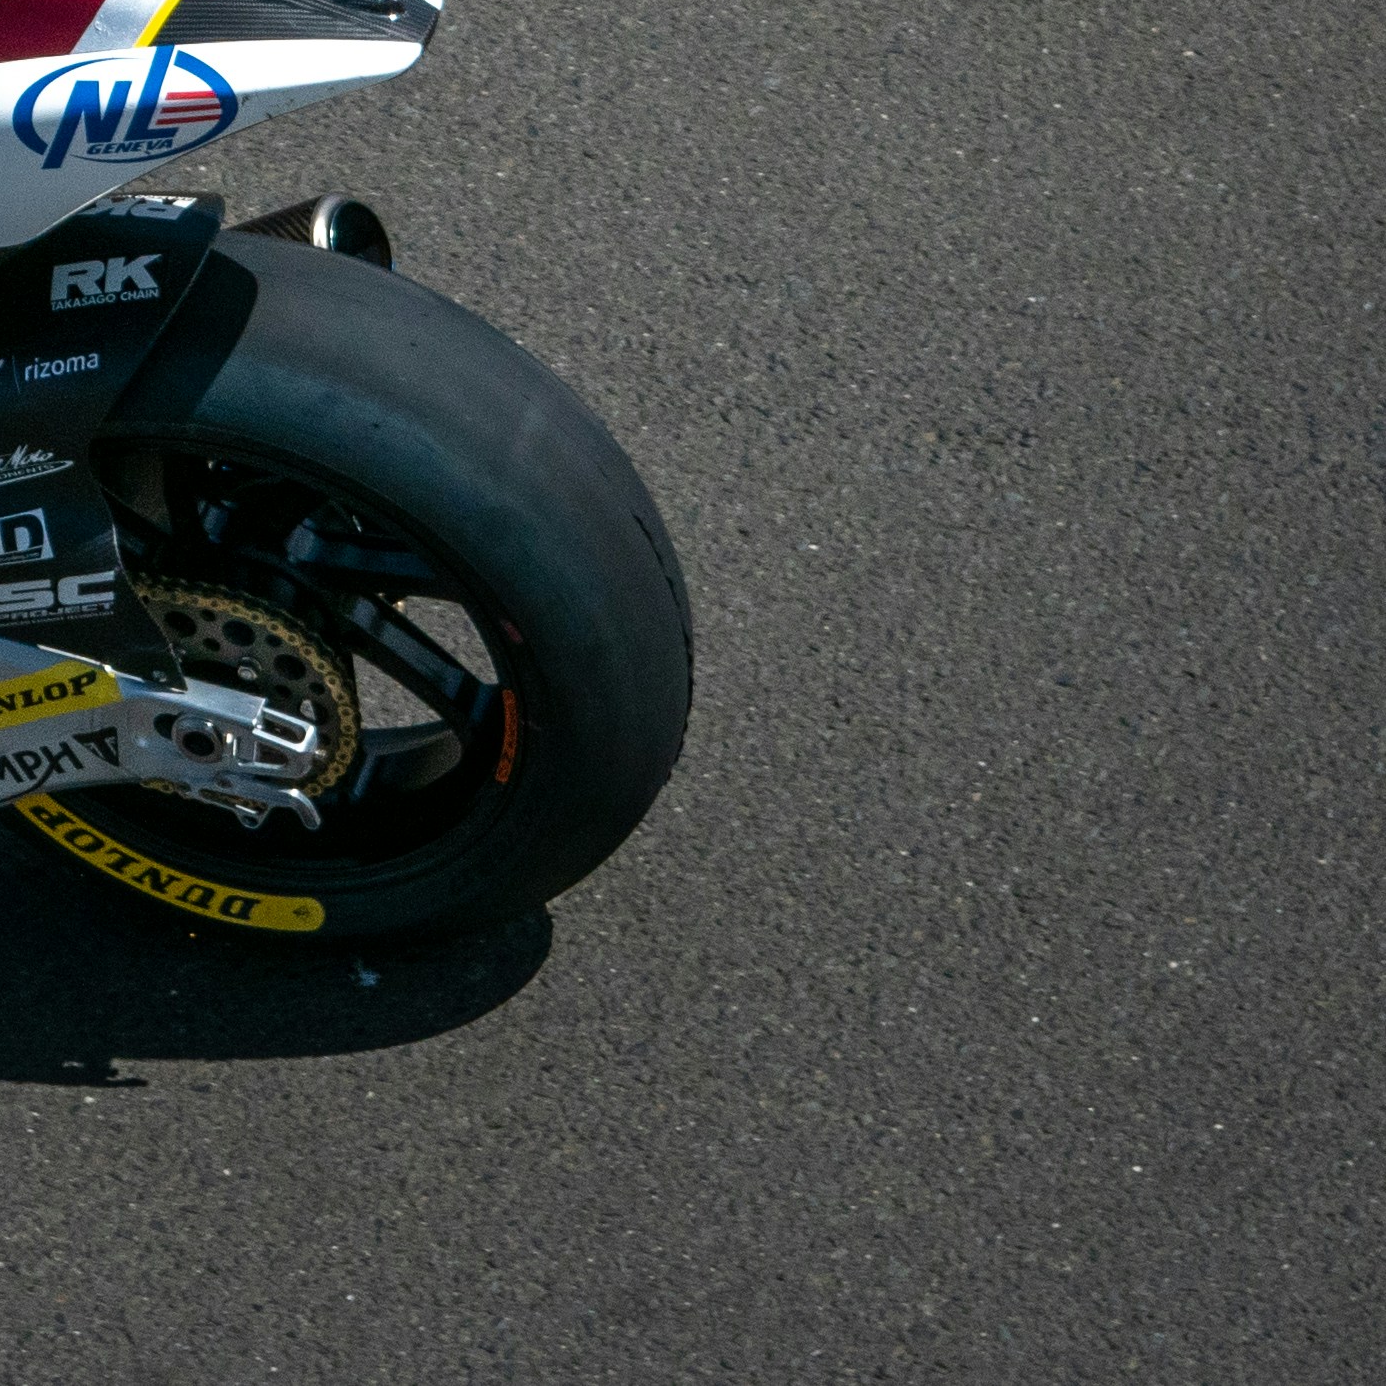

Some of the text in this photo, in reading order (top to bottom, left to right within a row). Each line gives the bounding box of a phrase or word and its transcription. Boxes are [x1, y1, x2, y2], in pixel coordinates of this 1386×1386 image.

[85, 137, 174, 157] GENEVA
[50, 253, 163, 302] RK
[51, 288, 160, 312] TAKASAGO CHAIN
[24, 352, 100, 382] rizoma
[29, 804, 262, 923] DUNLOP
